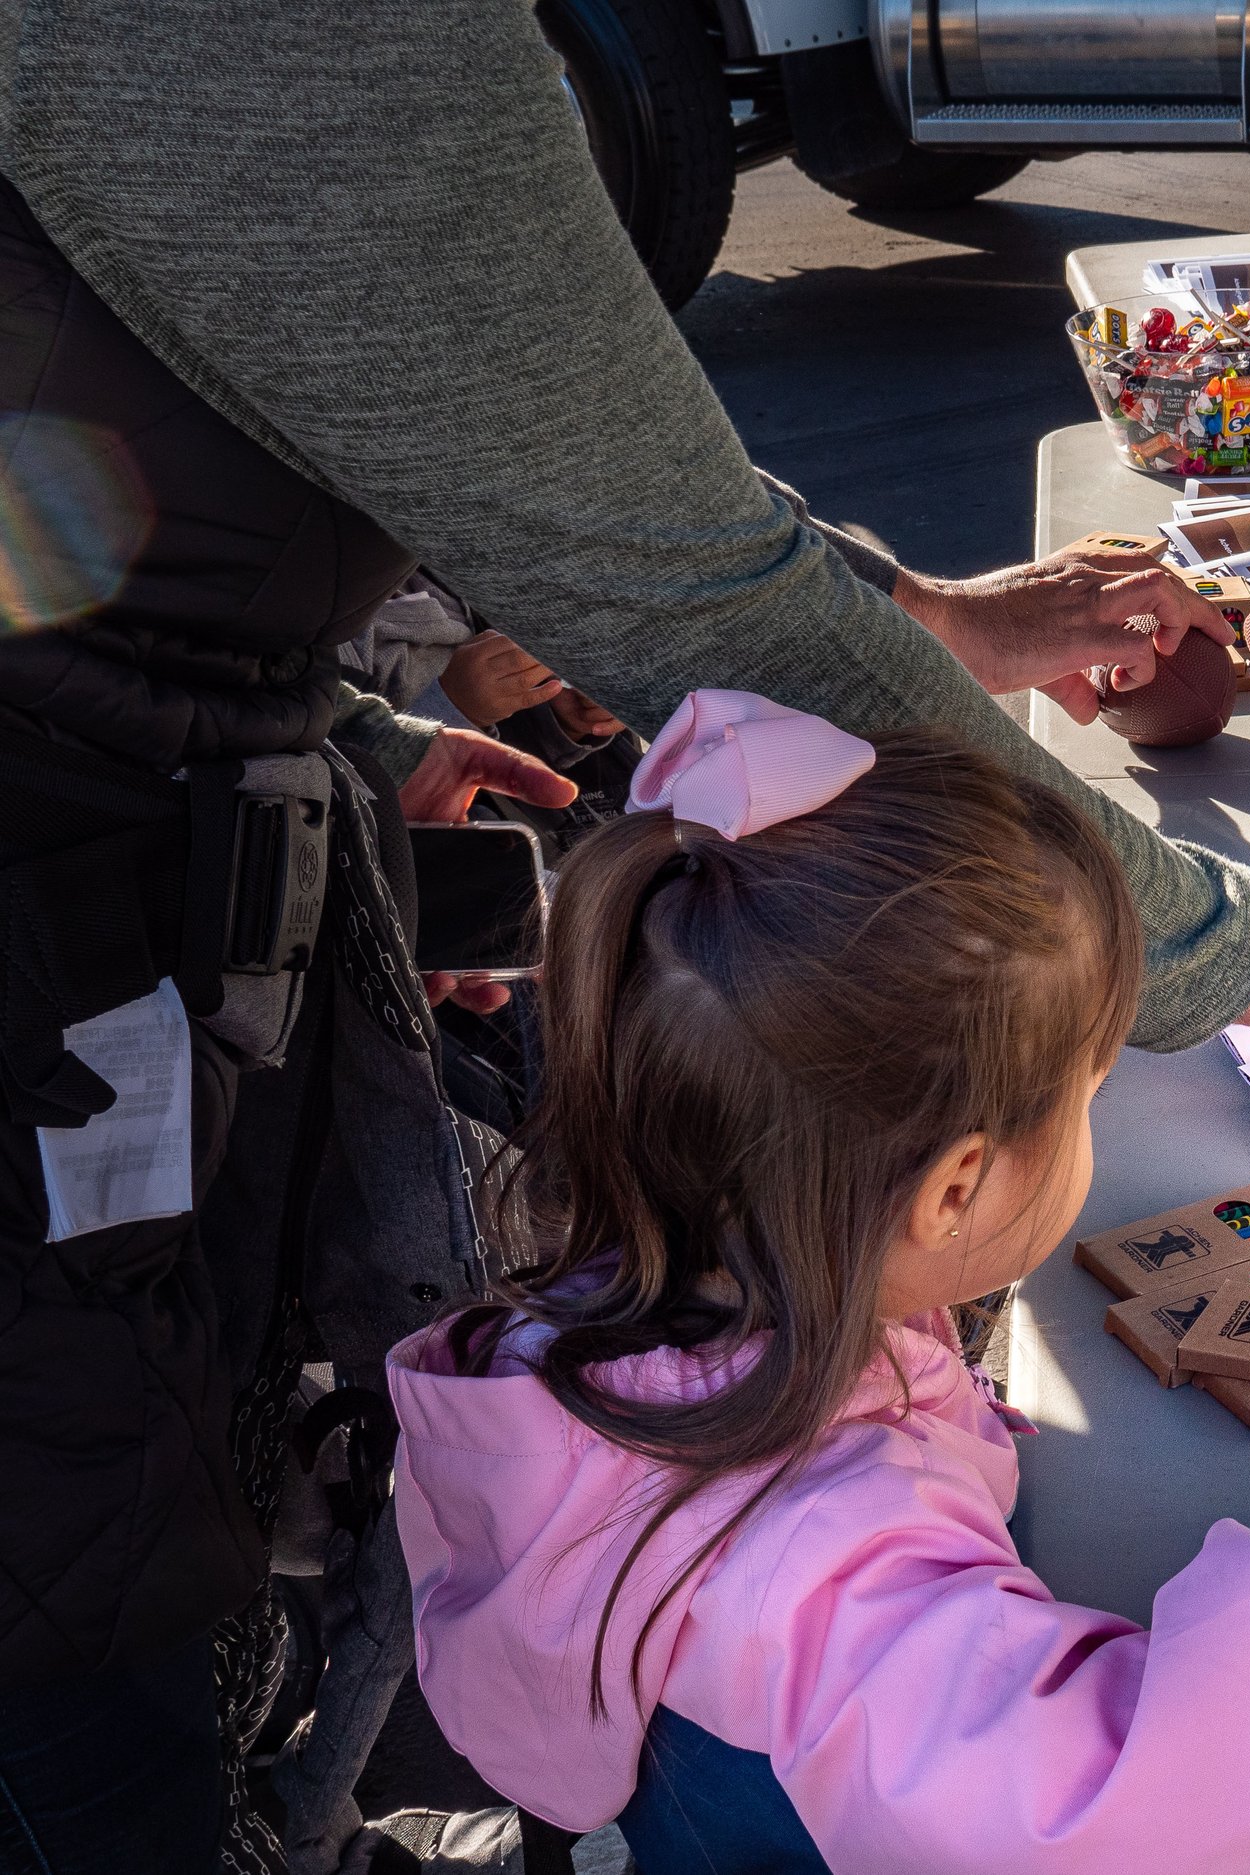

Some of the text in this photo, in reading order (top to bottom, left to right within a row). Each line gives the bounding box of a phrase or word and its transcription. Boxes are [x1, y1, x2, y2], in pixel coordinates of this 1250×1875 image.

[1111, 314, 1121, 344] DOTS
[1186, 1227, 1213, 1248] ACHEN
[1117, 1242, 1154, 1274] GARDNER
[1151, 1310, 1185, 1340] GARDNE
[1218, 1300, 1249, 1337] GARDNER
